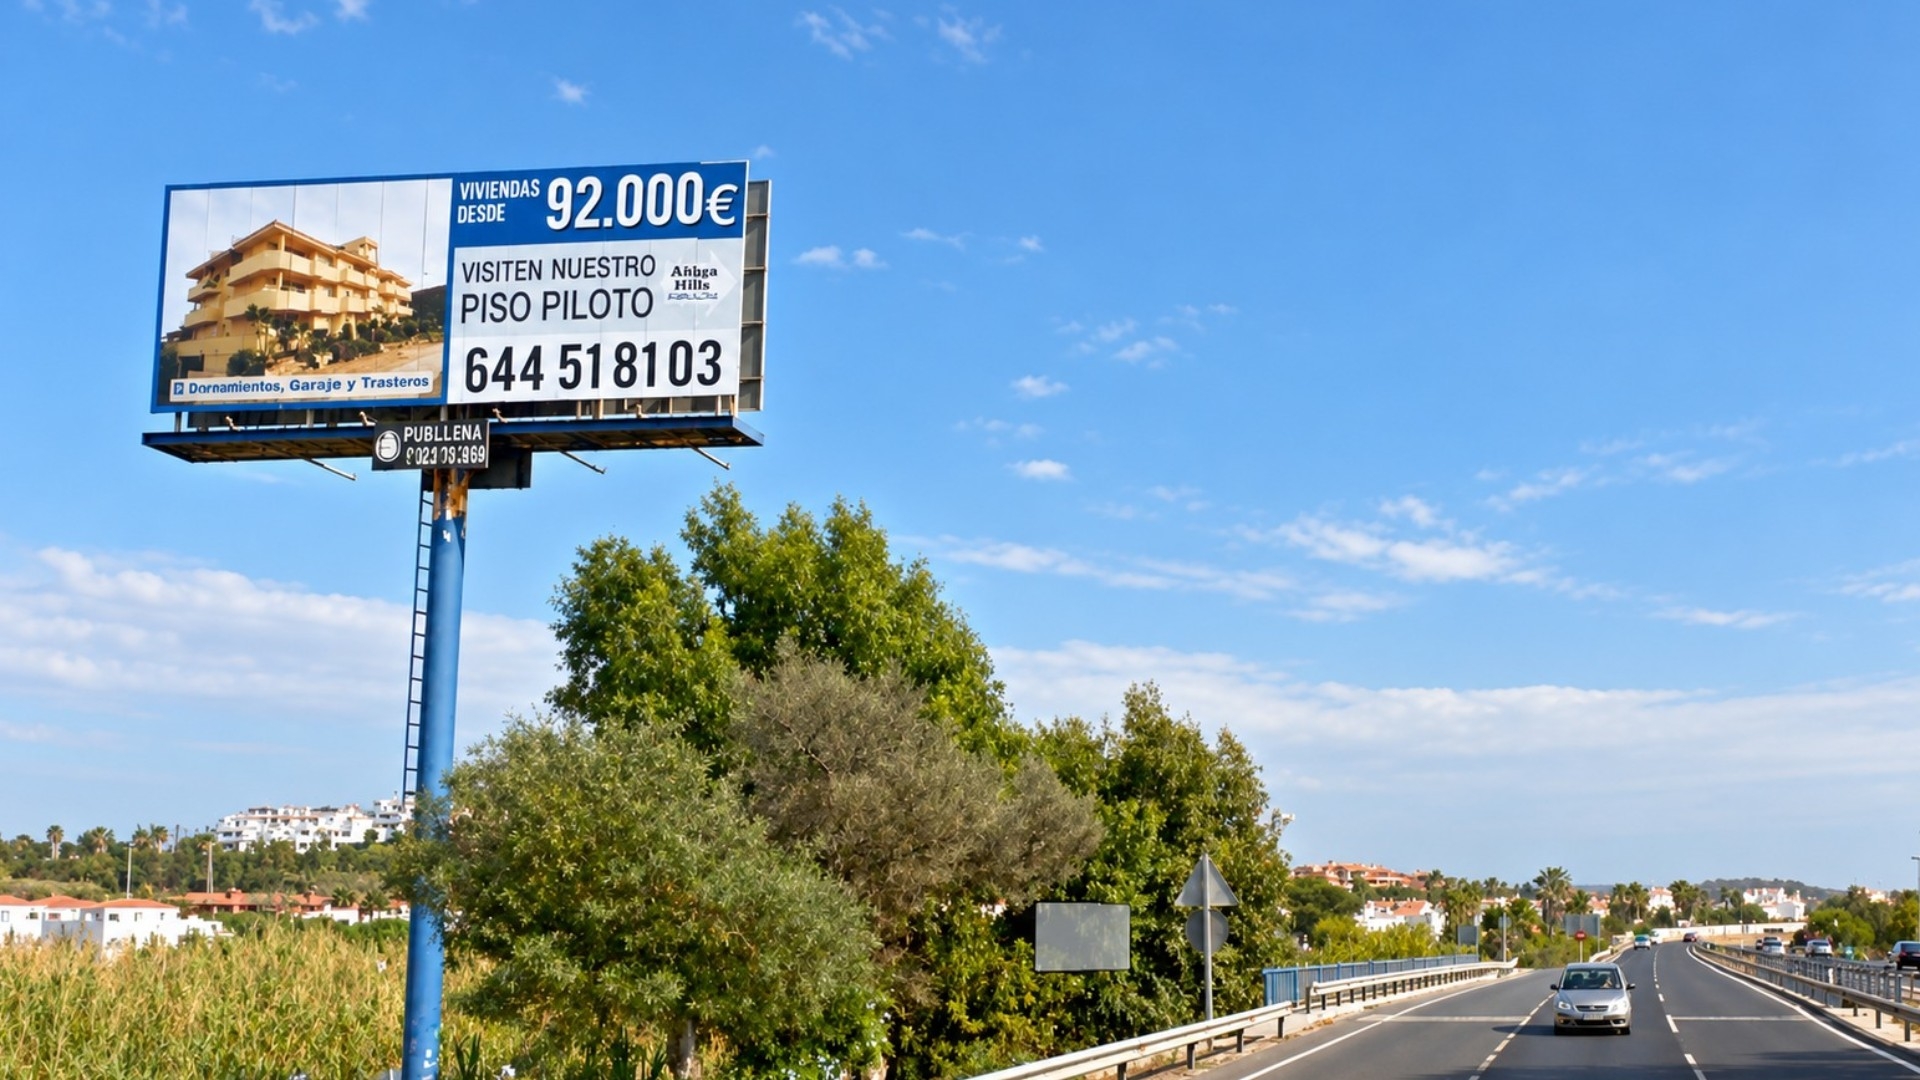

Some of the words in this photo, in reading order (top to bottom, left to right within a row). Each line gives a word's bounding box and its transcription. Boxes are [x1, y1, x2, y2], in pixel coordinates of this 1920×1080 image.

[460, 178, 540, 200] VIVIENDAS
[546, 171, 739, 231] 92.000€
[457, 203, 506, 224] DESDE
[461, 259, 543, 283] VISITEN
[551, 254, 656, 280] NUESTRO
[674, 279, 710, 291] Hills
[461, 291, 531, 324] PISO
[542, 287, 654, 321] PILOTO
[465, 345, 545, 393] 644
[289, 378, 342, 393] Garaje
[347, 379, 356, 391] y
[361, 375, 429, 388] Trasteros
[403, 423, 482, 443] PUBLLENA
